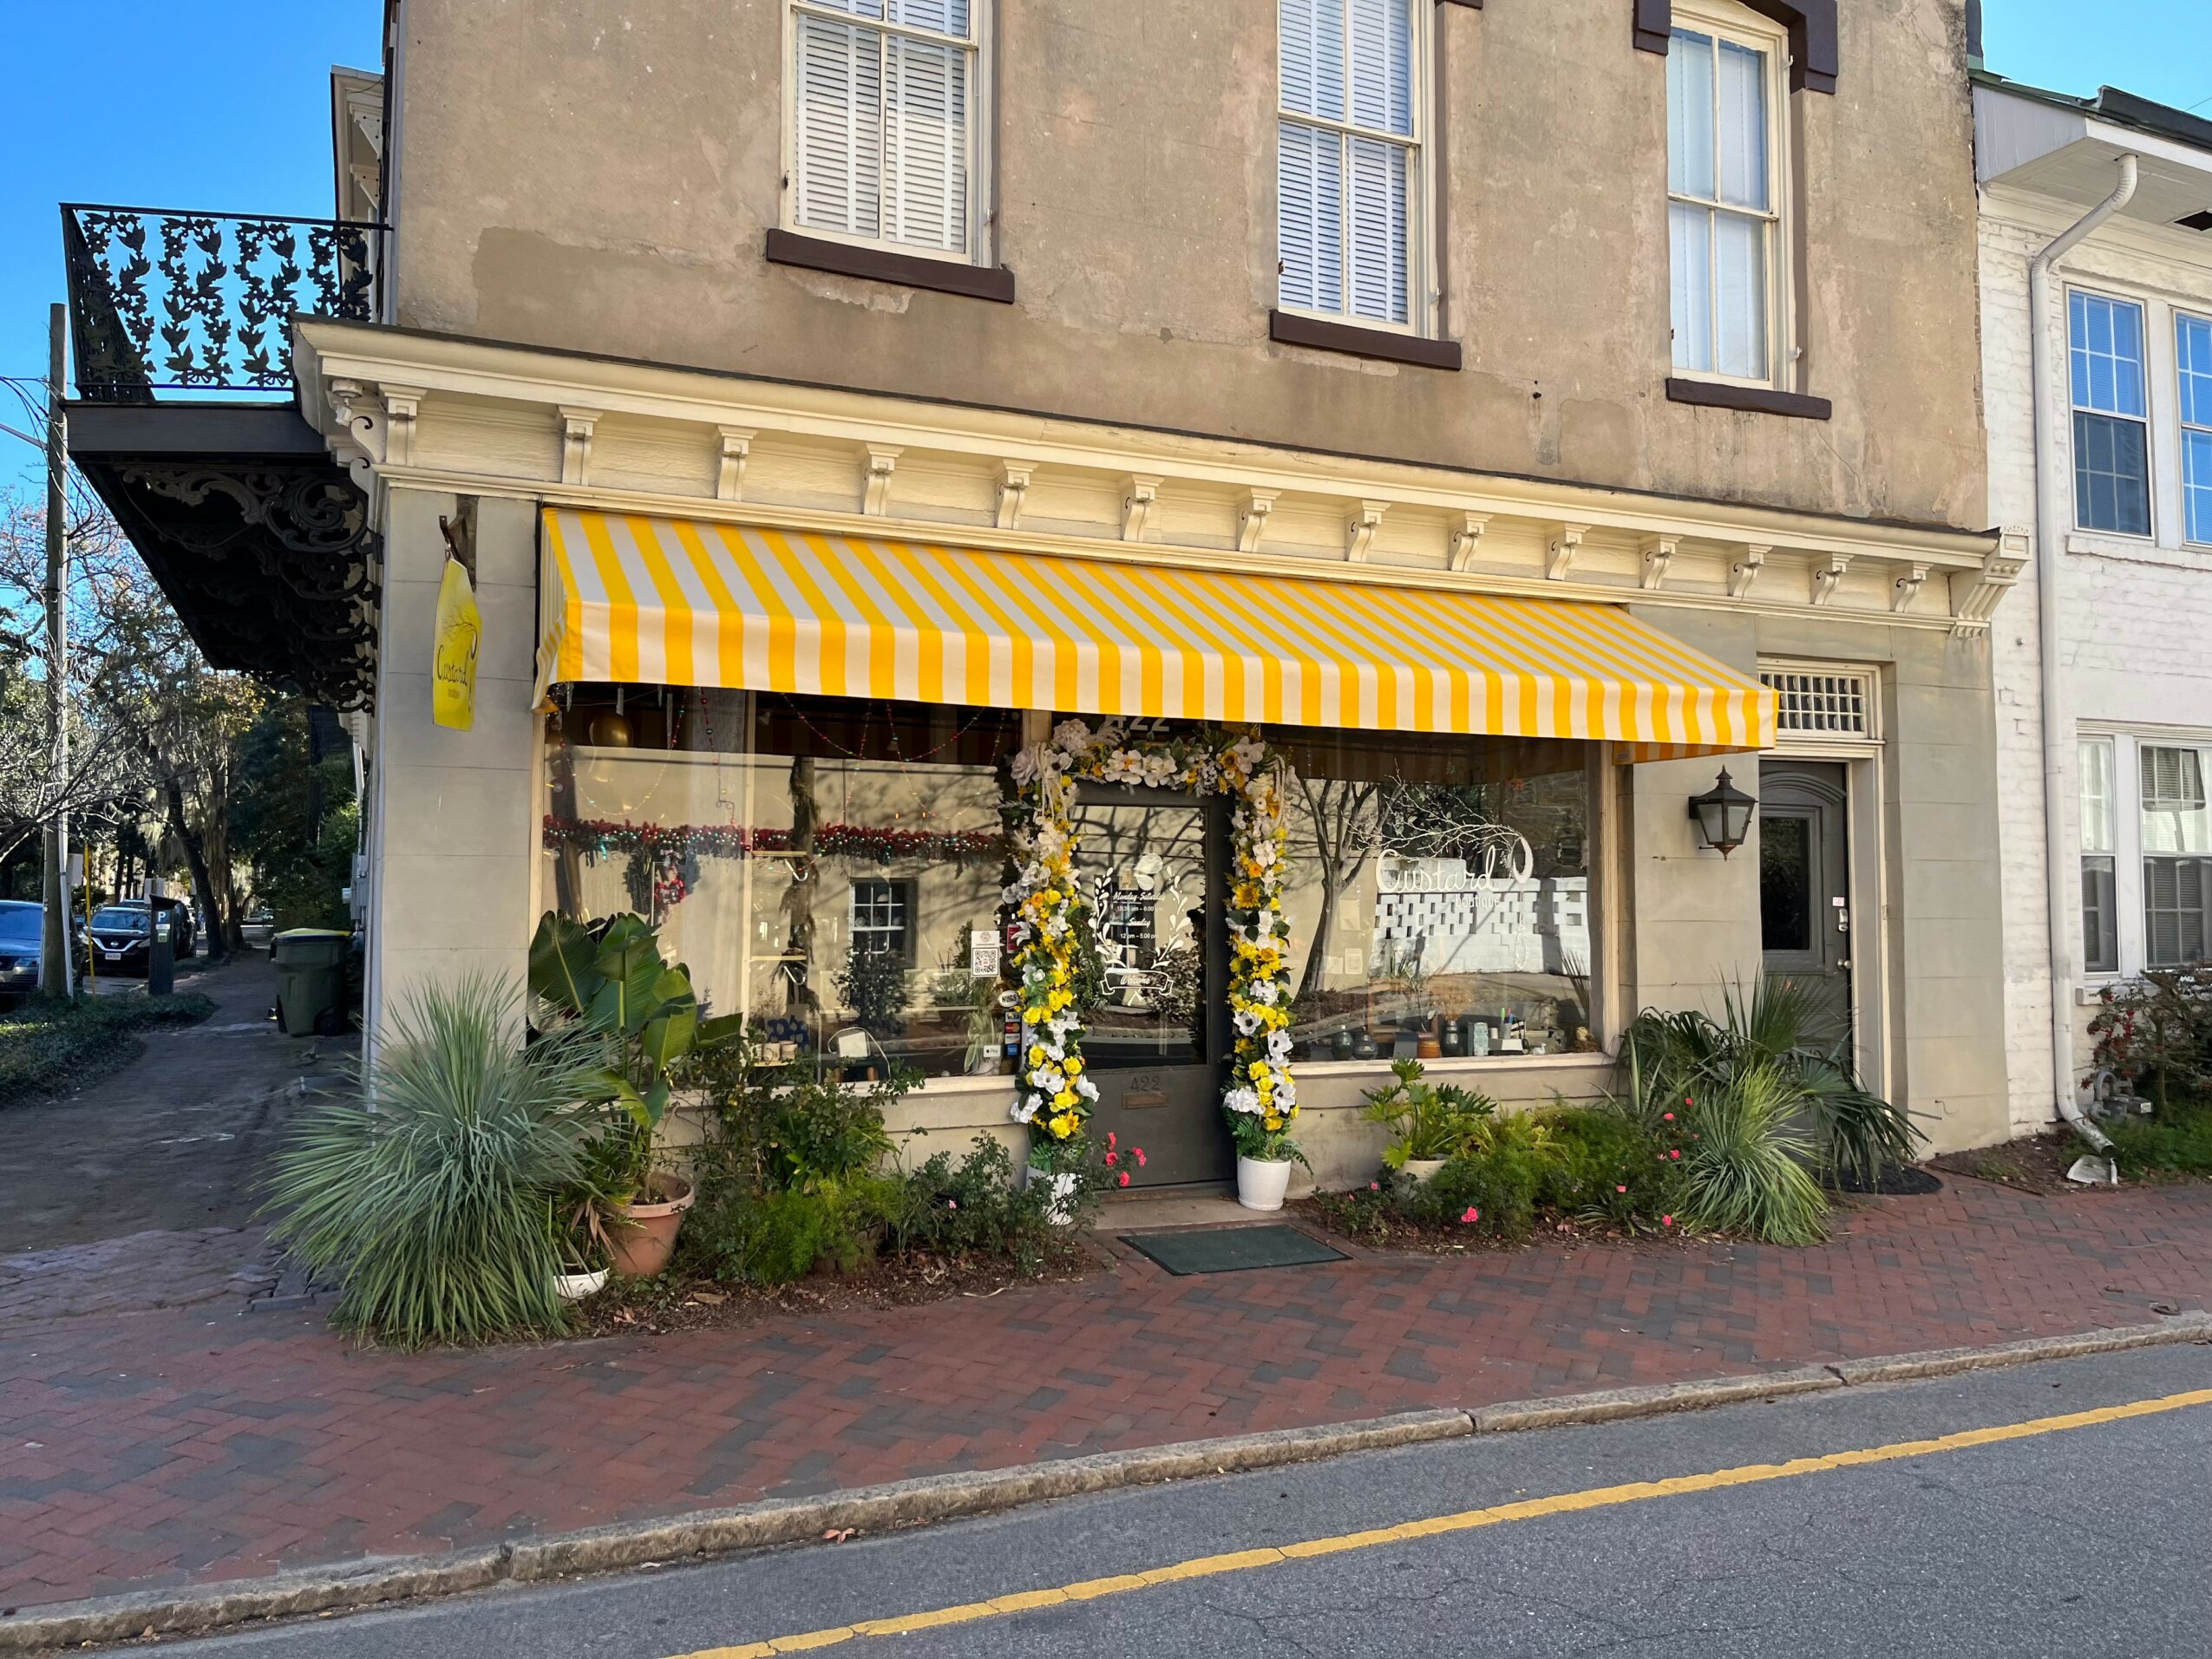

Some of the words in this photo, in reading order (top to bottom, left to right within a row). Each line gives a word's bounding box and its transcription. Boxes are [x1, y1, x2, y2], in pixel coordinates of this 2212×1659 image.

[437, 644, 469, 686] Custard
[1375, 844, 1499, 894] Custard
[1455, 896, 1500, 908] boutique
[1129, 918, 1150, 928] Sunday
[1120, 973, 1150, 986] Welcome
[1130, 1075, 1161, 1092] 422
